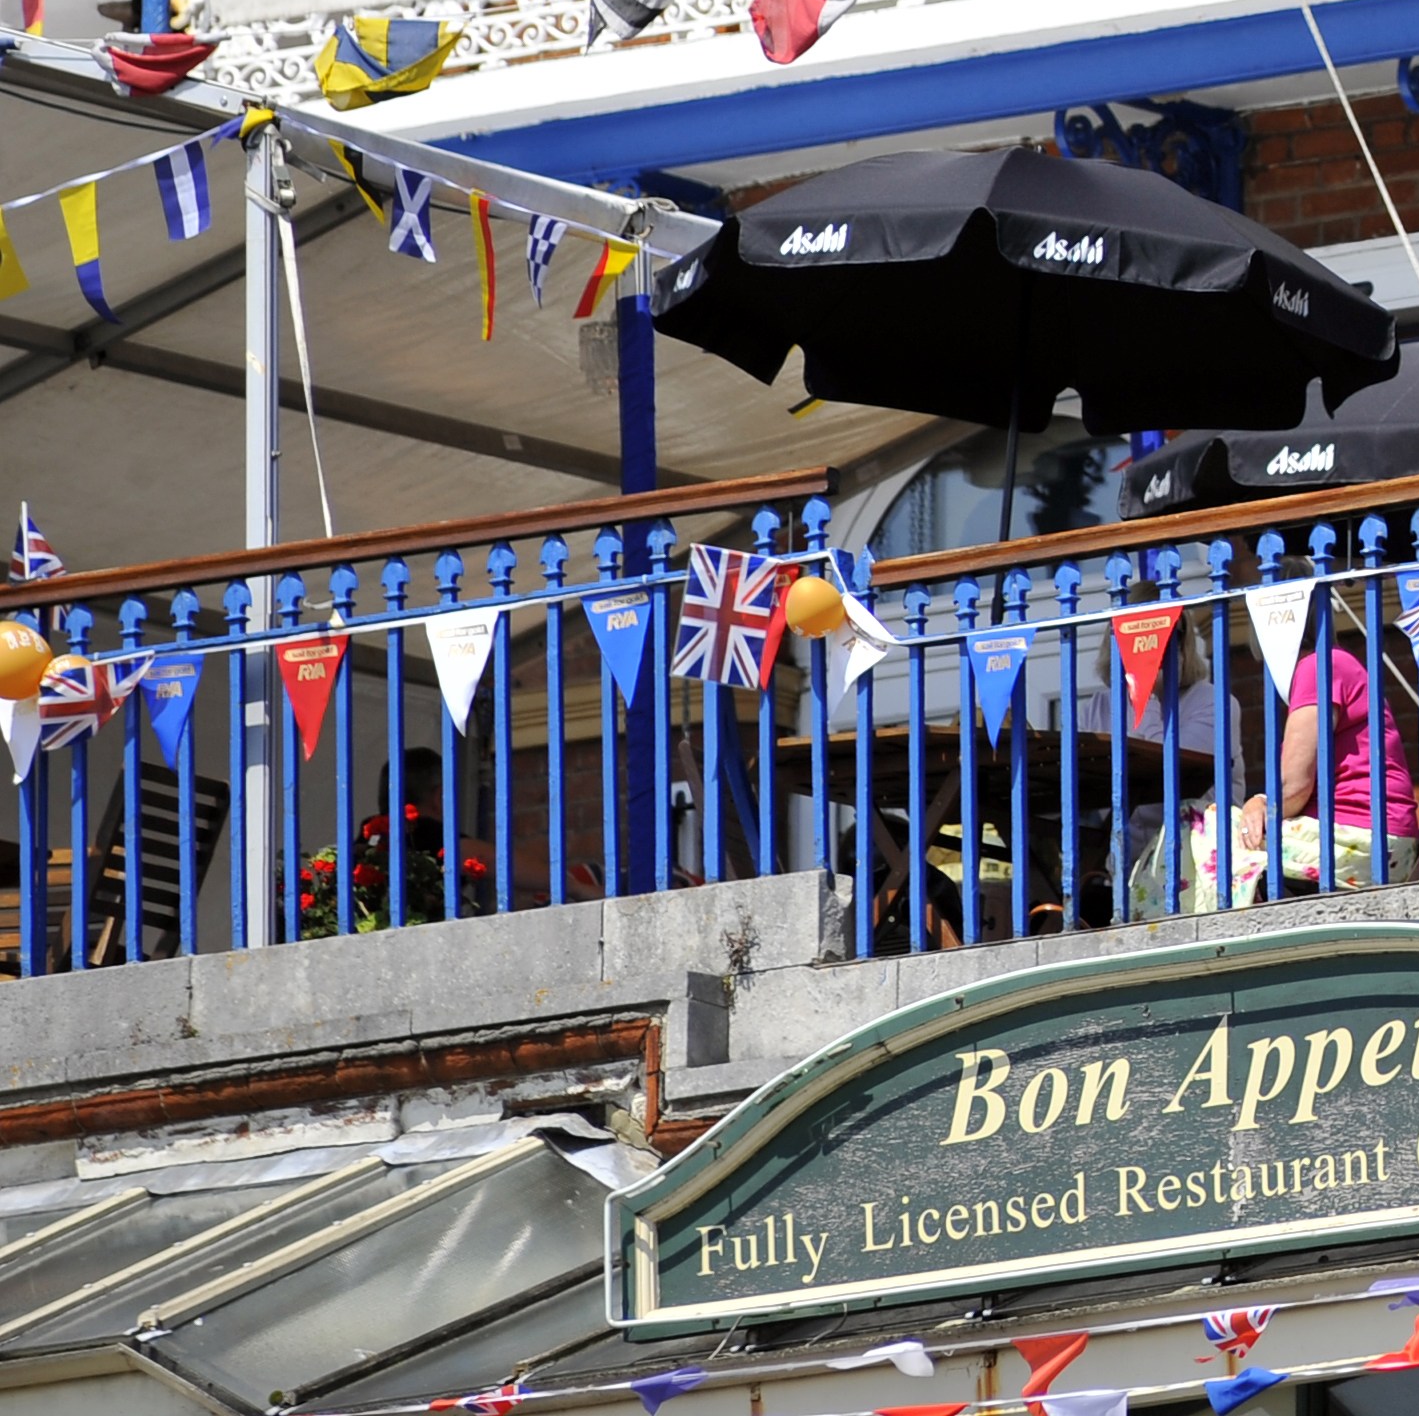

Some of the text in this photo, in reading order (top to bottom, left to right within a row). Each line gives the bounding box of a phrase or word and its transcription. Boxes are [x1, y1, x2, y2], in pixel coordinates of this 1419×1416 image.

[779, 223, 848, 256] Asahi
[1033, 231, 1104, 265] Asahi
[1272, 280, 1310, 318] Asahi
[1266, 443, 1335, 476] Asahi
[607, 609, 638, 631] RYA
[1268, 609, 1296, 626] RYA
[1133, 634, 1158, 653] RYA
[297, 663, 326, 681] RYA
[940, 1047, 1132, 1147] Bon
[696, 1213, 829, 1284] Fully
[860, 1171, 1088, 1253] Licensed
[1113, 1137, 1391, 1217] Restaurant
